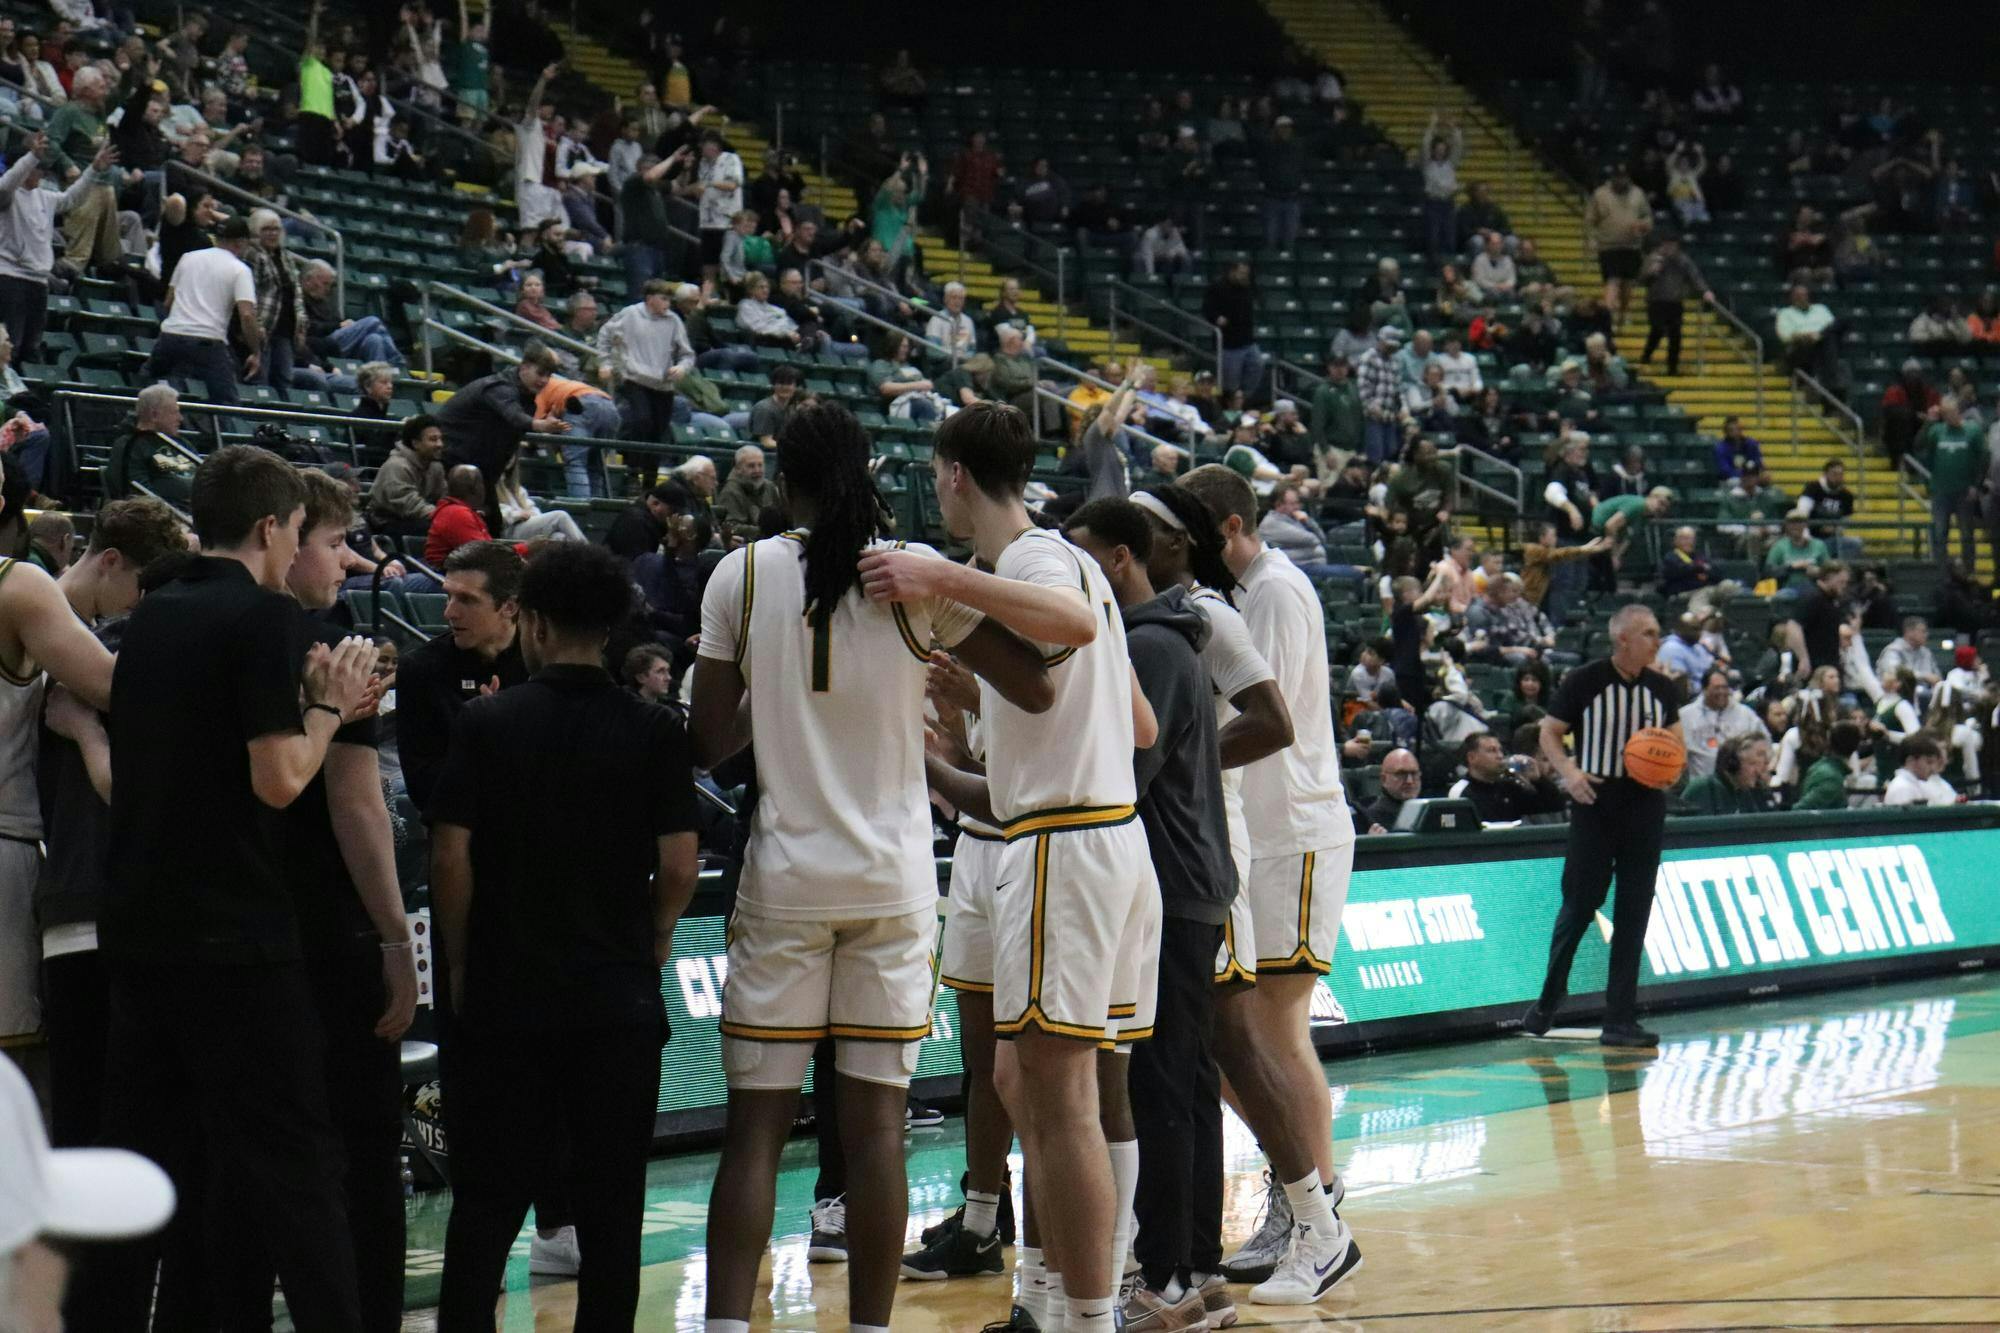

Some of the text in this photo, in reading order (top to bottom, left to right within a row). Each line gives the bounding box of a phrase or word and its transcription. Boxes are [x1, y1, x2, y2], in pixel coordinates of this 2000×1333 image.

[807, 606, 832, 692] 1
[1417, 894, 1485, 944] STATE
[1788, 845, 1954, 955] CENTER
[1357, 960, 1423, 990] RAIDERS
